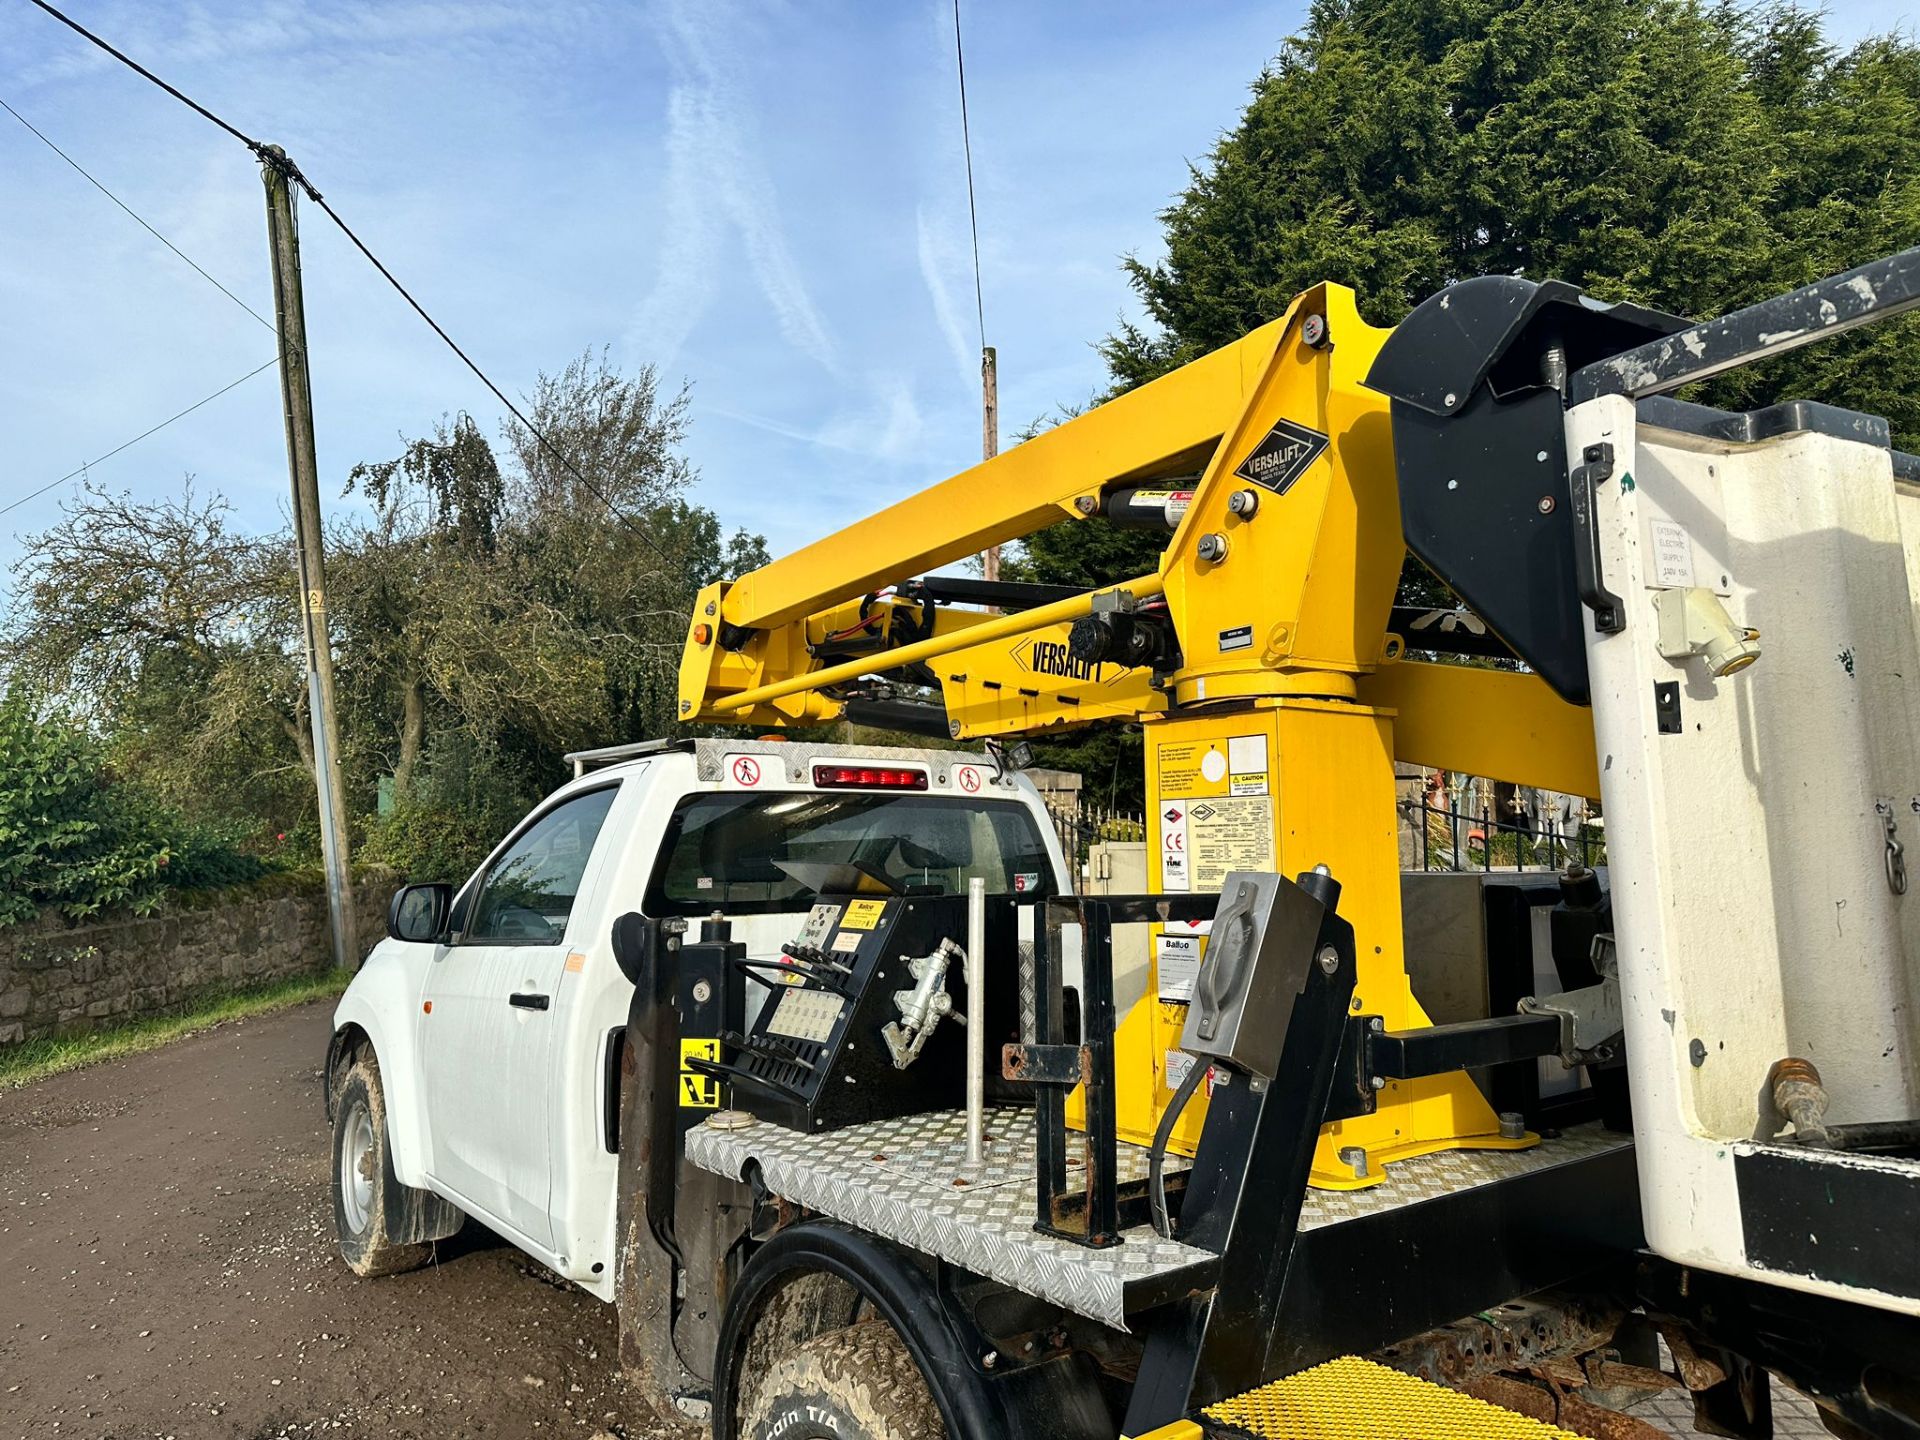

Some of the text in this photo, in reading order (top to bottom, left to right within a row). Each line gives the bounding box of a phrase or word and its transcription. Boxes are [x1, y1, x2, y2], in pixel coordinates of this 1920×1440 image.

[1248, 443, 1300, 474] VERSALIFT
[1663, 553, 1684, 562] SUPPLY
[1015, 875, 1025, 890] 5
